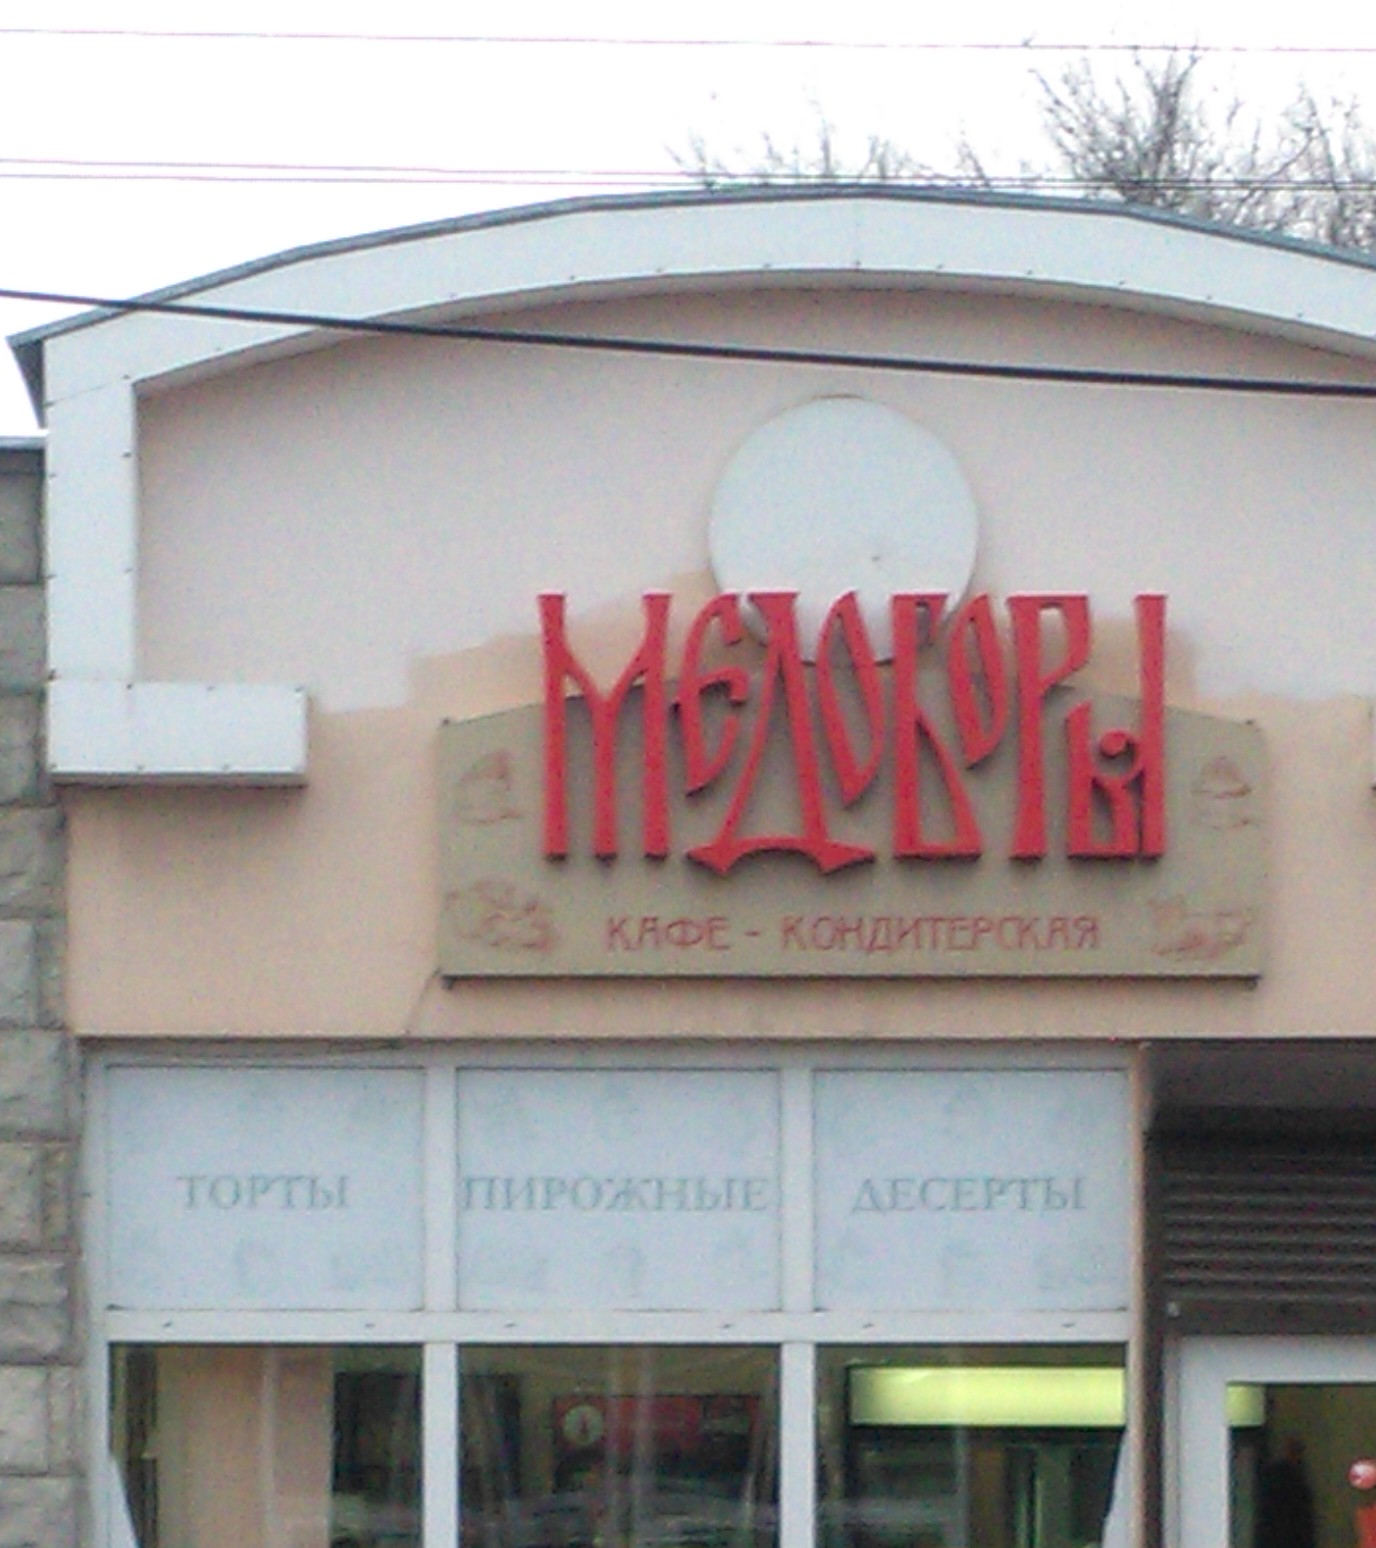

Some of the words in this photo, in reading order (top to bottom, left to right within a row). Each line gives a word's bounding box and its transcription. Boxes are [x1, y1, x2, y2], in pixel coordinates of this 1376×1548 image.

[603, 913, 732, 953] КАФЕ
[779, 913, 1102, 955] КОНДИТЕРСКАЯ
[177, 1174, 350, 1214] ТОРТЫ
[460, 1175, 770, 1214] ПИРОЖНЫЕ
[849, 1174, 1086, 1215] ДЕСЕРТЫ
